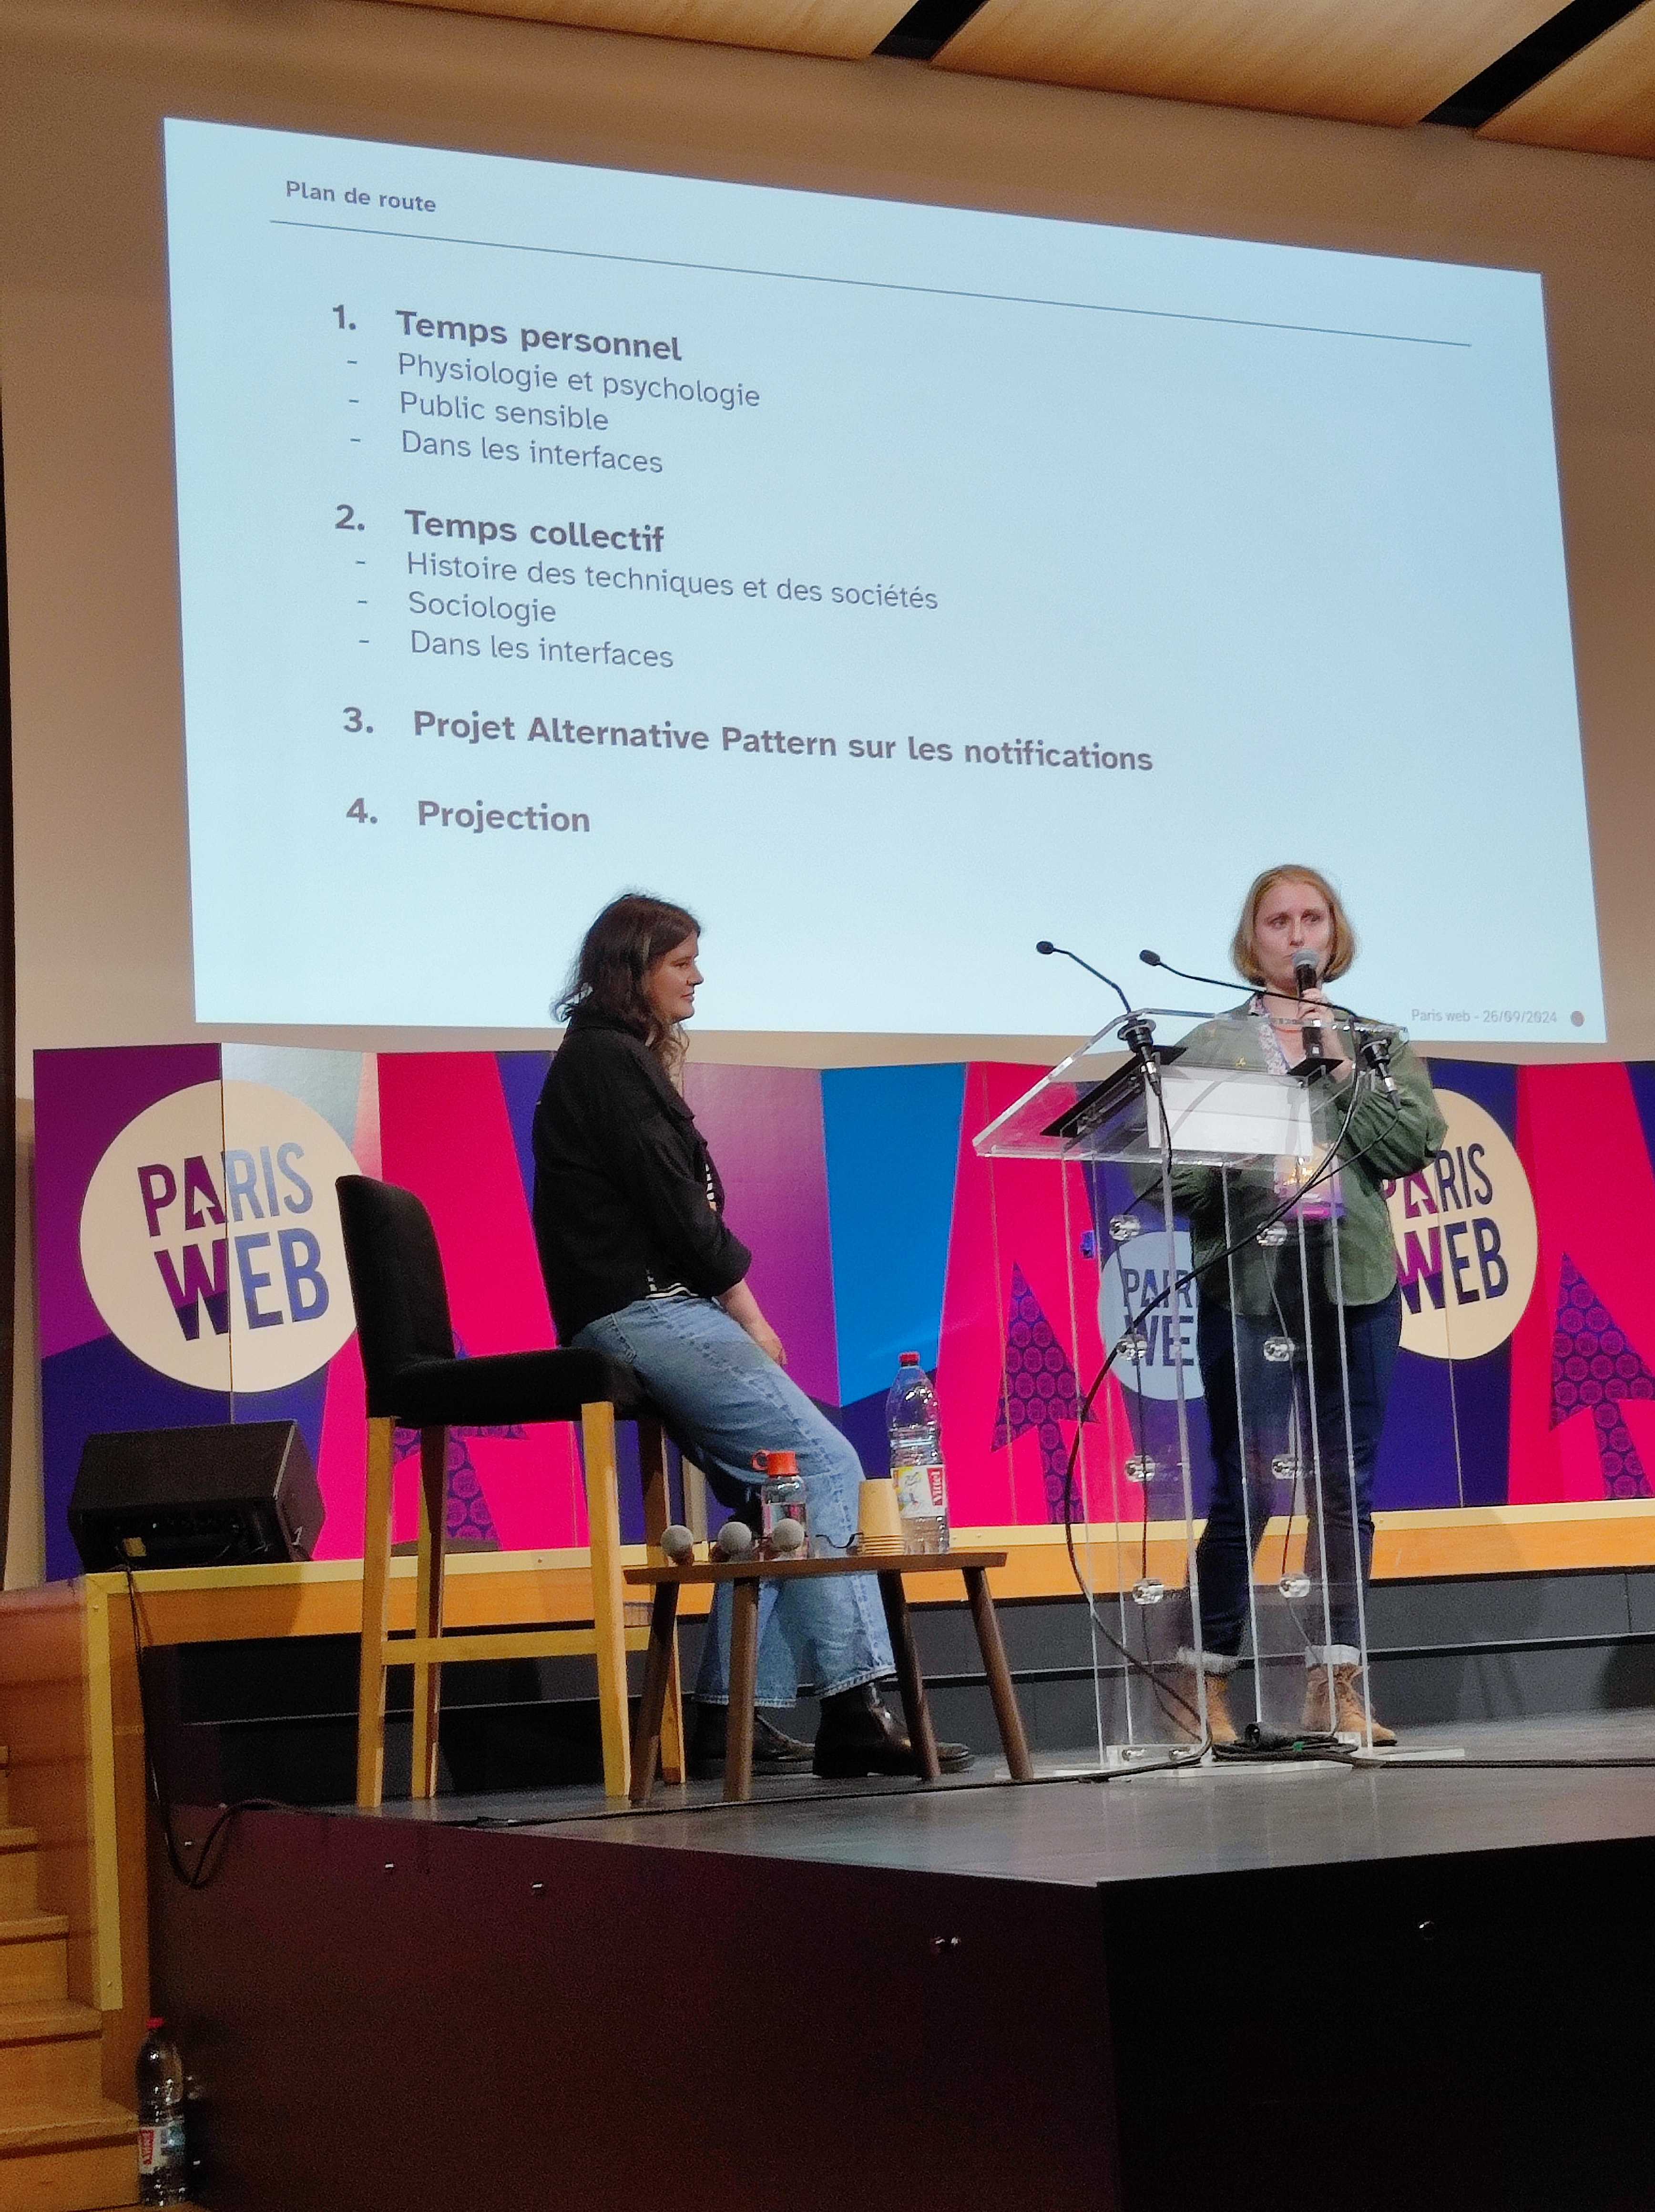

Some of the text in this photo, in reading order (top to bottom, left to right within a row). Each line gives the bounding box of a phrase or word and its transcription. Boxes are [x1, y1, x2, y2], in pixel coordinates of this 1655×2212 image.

[286, 181, 436, 212] Plan de route
[333, 305, 682, 361] 1. Temps personnel
[399, 353, 557, 392] Physiologie
[568, 372, 593, 392] et
[603, 377, 759, 410] psychologie
[401, 391, 484, 420] Public
[495, 404, 608, 430] sensible
[403, 430, 471, 457] Dans
[482, 437, 519, 461] les
[530, 440, 663, 473] interfaces
[335, 504, 664, 552] 2. Temps collectif
[408, 552, 517, 581] Histoire
[528, 561, 575, 585] des
[585, 566, 733, 598] techniques
[744, 578, 767, 598] et
[777, 578, 822, 601] des
[832, 584, 938, 609] sociétés
[409, 591, 556, 627] Sociologie
[411, 630, 480, 656] Dans
[491, 635, 529, 659] les
[539, 637, 673, 668] interfaces
[343, 707, 1153, 771] 3. Projet Alternative Pattern sur les notifications
[346, 798, 590, 833] 4. Projection
[1411, 1008, 1442, 1022] Paris
[1445, 1011, 1471, 1022] web
[1483, 1010, 1557, 1023] 26/09/2024
[137, 1142, 313, 1238] PARIS
[154, 1228, 329, 1341] WEB
[1395, 1217, 1509, 1315] WEB
[1123, 1315, 1194, 1366] WE
